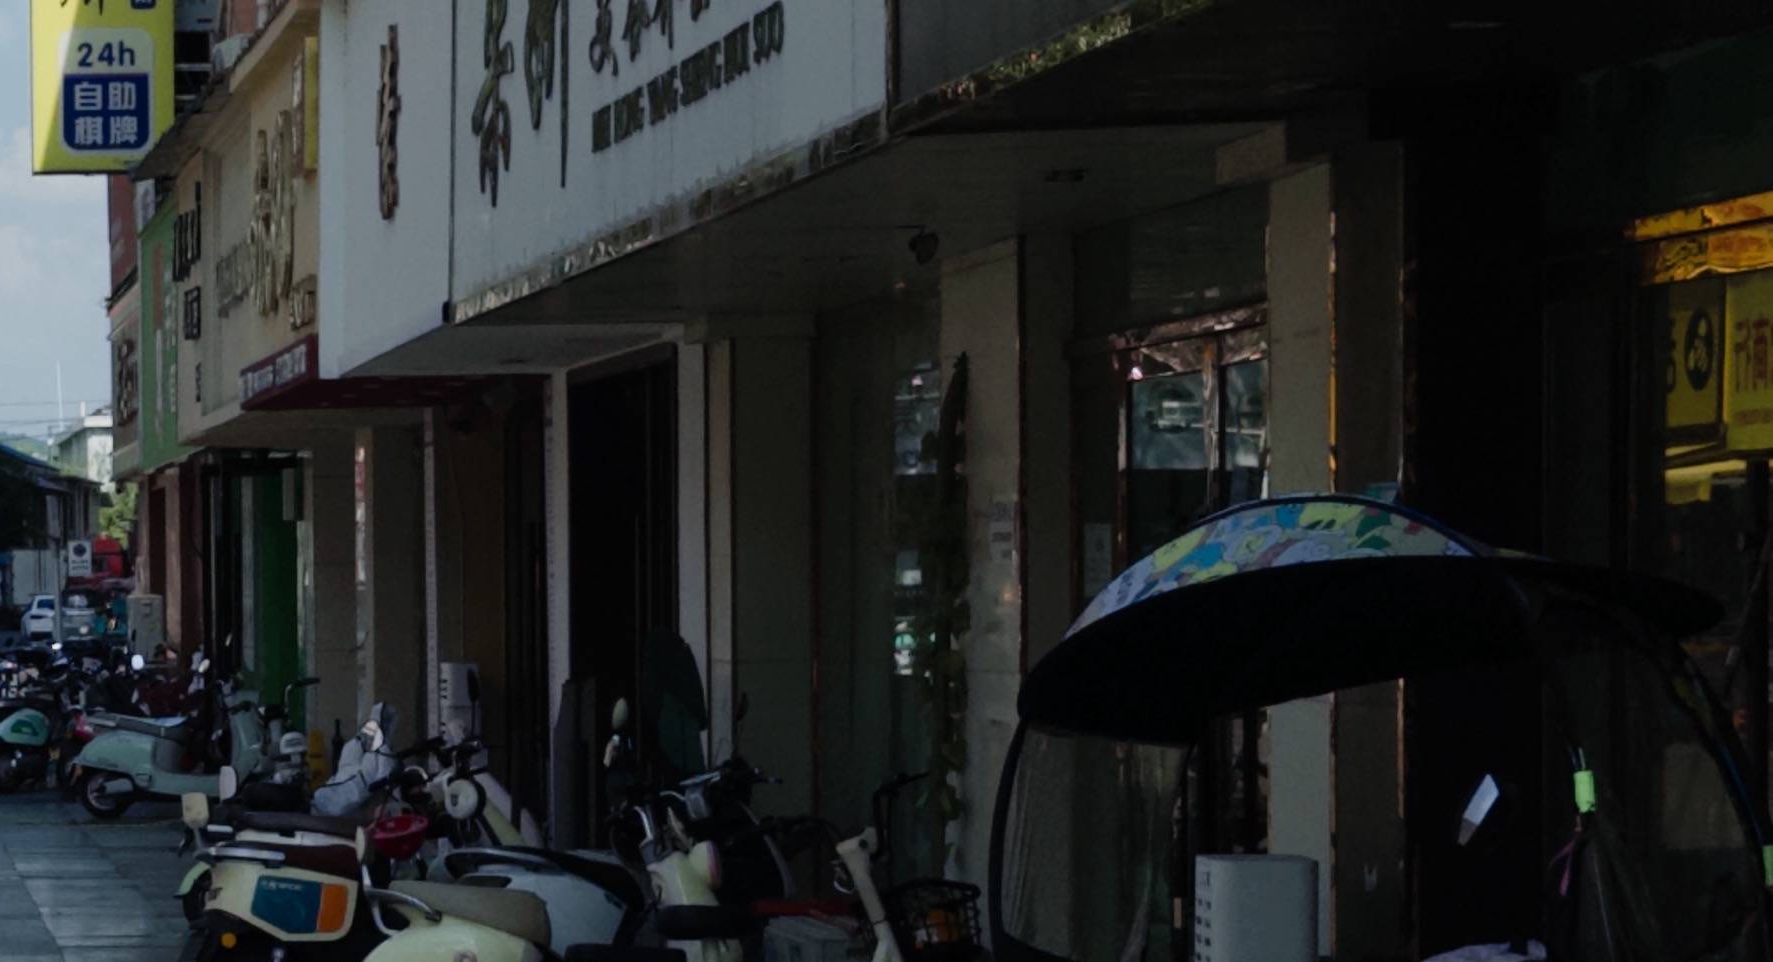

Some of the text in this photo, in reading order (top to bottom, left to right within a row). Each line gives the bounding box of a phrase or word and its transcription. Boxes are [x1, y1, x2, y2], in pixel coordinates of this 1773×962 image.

[78, 41, 135, 67] 24h
[74, 82, 136, 110] 自助
[75, 116, 138, 145] 棋牌
